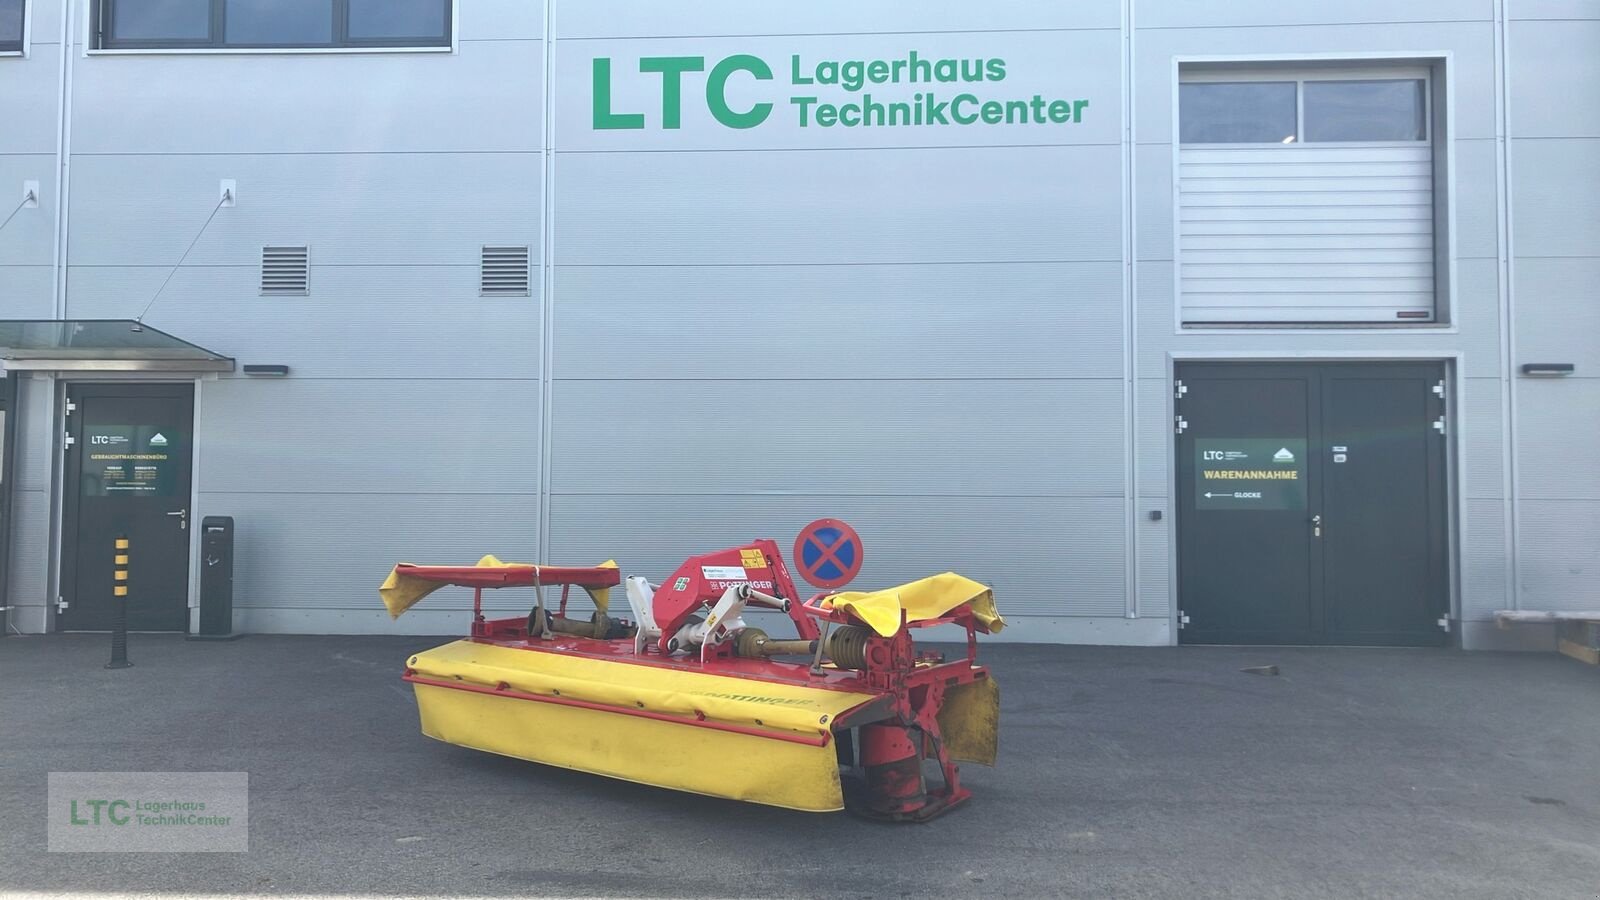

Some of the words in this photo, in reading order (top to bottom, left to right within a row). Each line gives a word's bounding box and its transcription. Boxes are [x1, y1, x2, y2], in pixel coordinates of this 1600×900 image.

[791, 51, 1006, 92] Lagerhaus
[593, 55, 774, 130] LTC
[791, 93, 1089, 128] TechnikCenter
[91, 435, 109, 444] LTC
[1203, 450, 1224, 460] LTC
[1204, 470, 1298, 480] WARENANNAHME
[1234, 491, 1262, 499] GLOCKE
